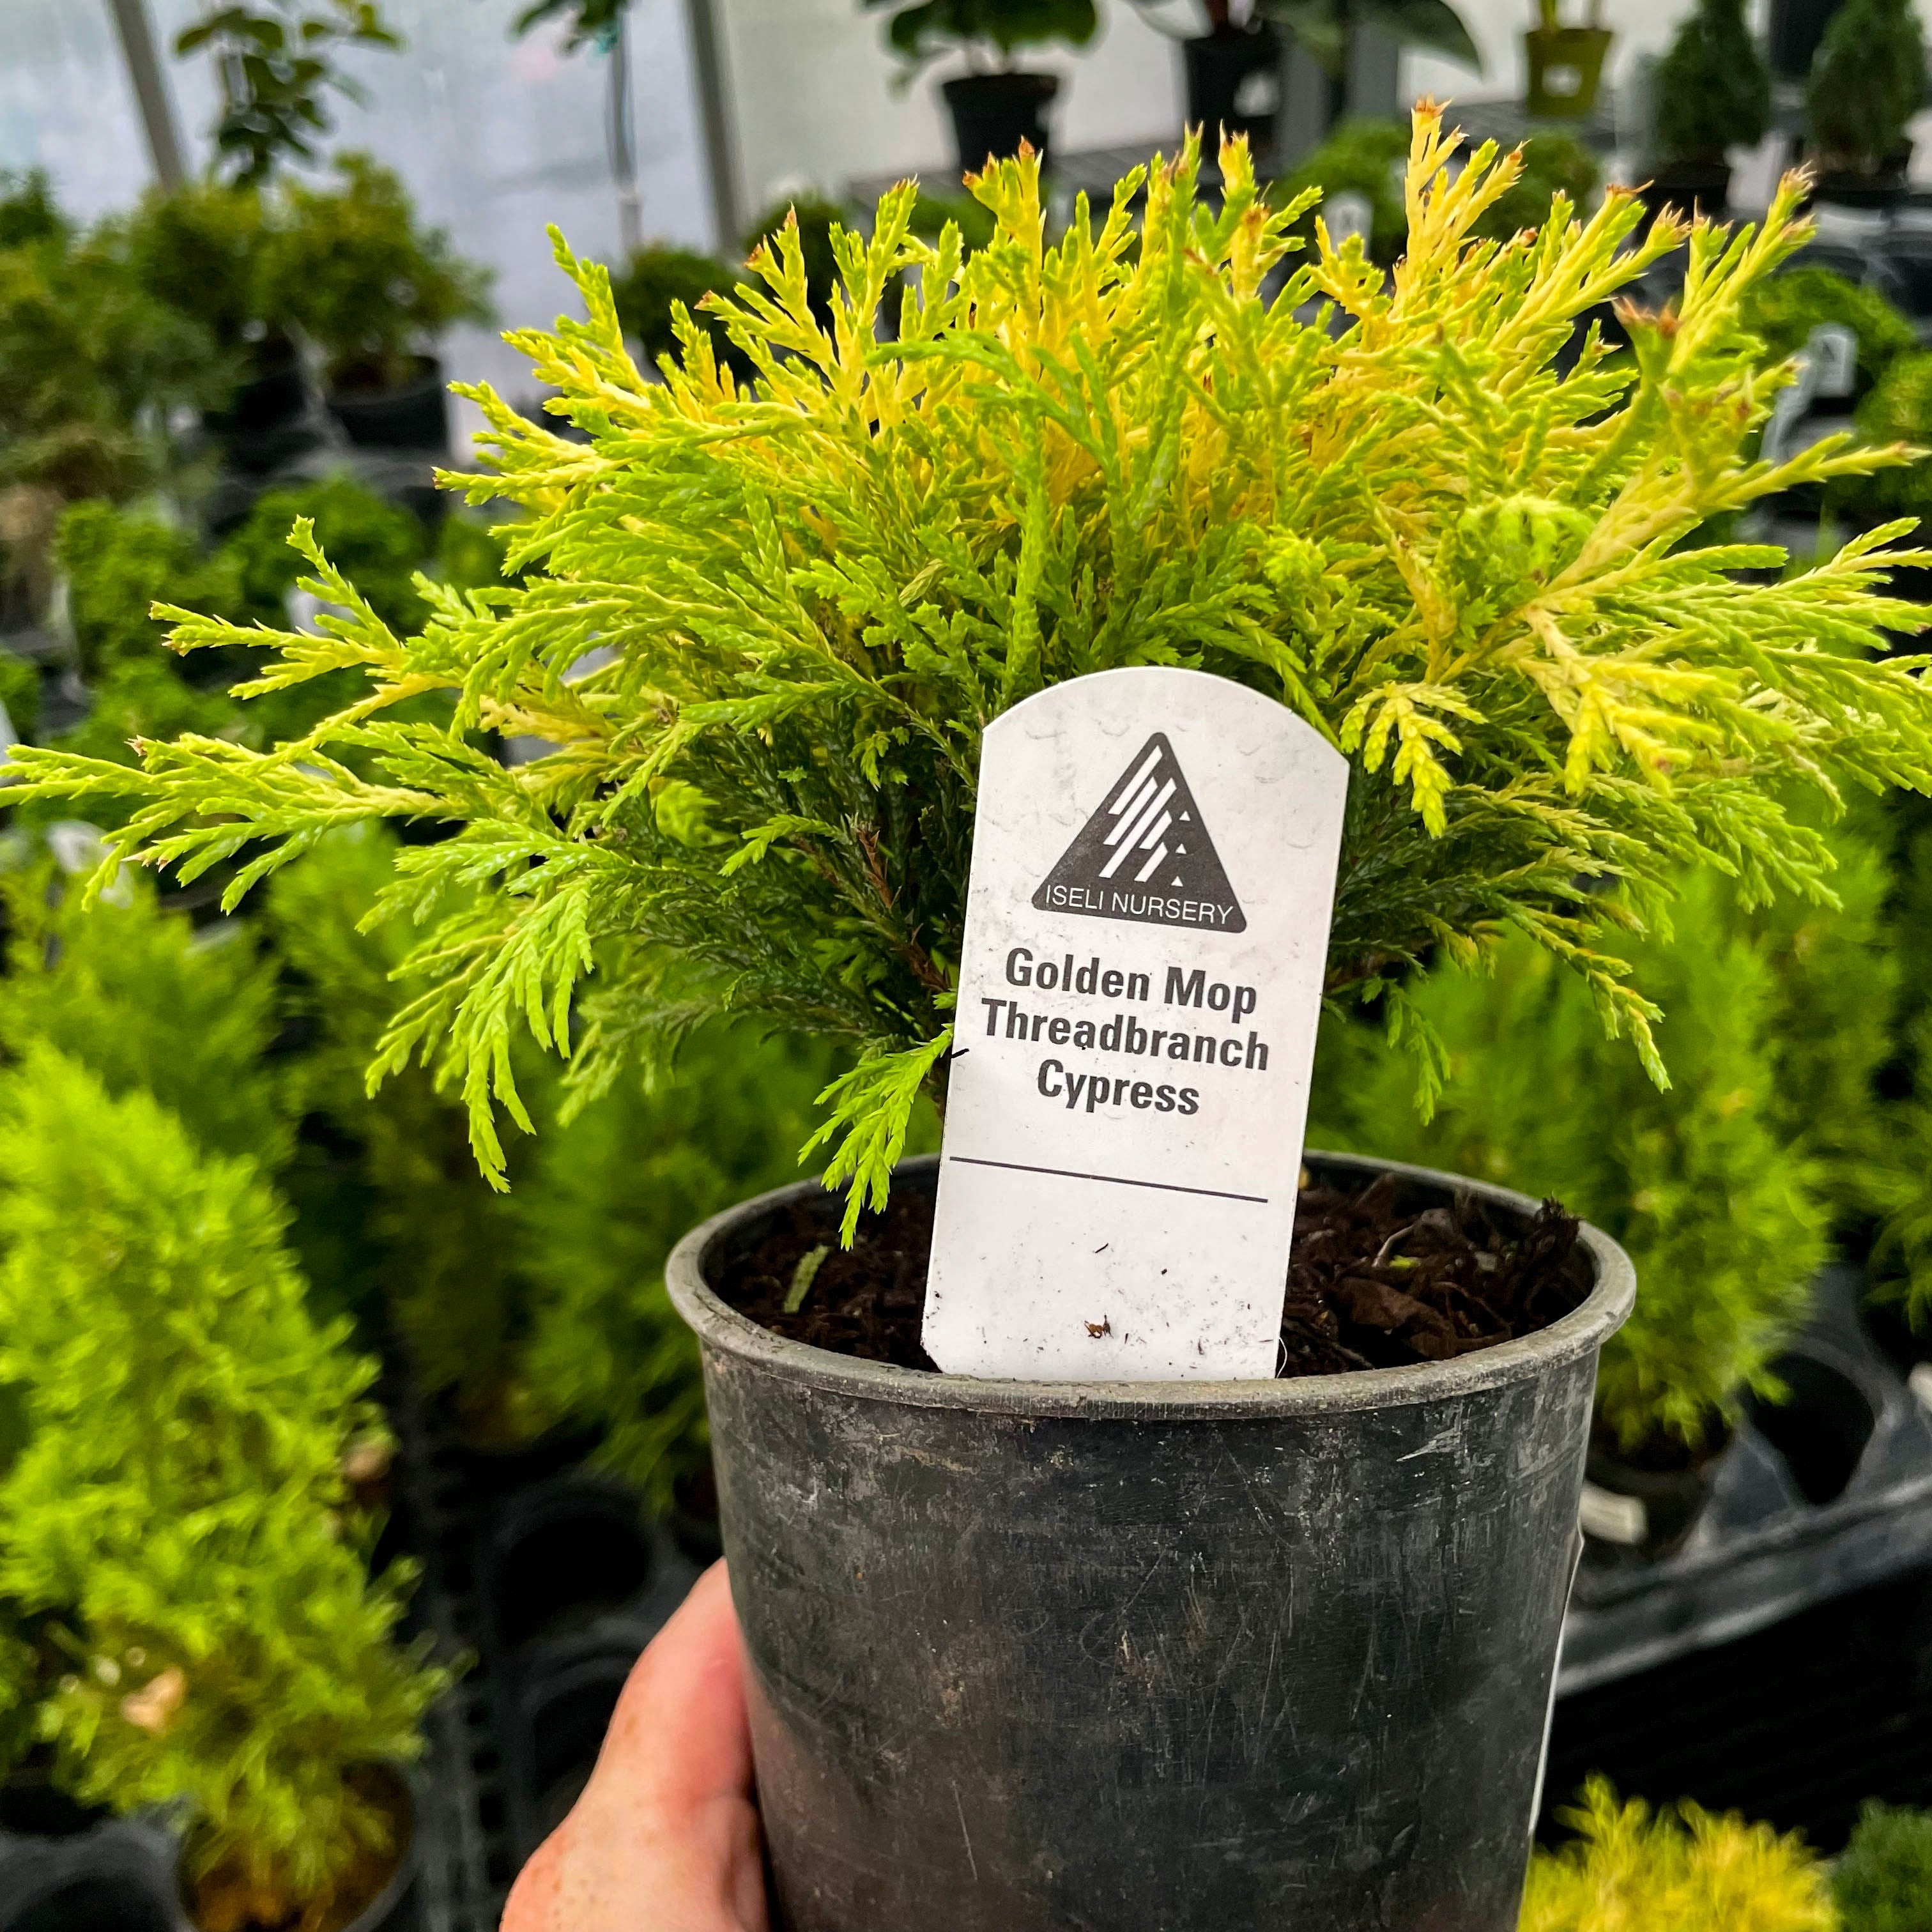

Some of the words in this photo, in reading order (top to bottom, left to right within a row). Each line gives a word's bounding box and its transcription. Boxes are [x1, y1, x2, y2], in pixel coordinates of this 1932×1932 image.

[1045, 884, 1104, 910] ISELI
[1111, 892, 1234, 924] NURSERY
[1005, 947, 1151, 1000] Golden
[1164, 966, 1257, 1024] Mop
[981, 998, 1269, 1071] Threadbranch
[1037, 1059, 1200, 1115] Cypress
